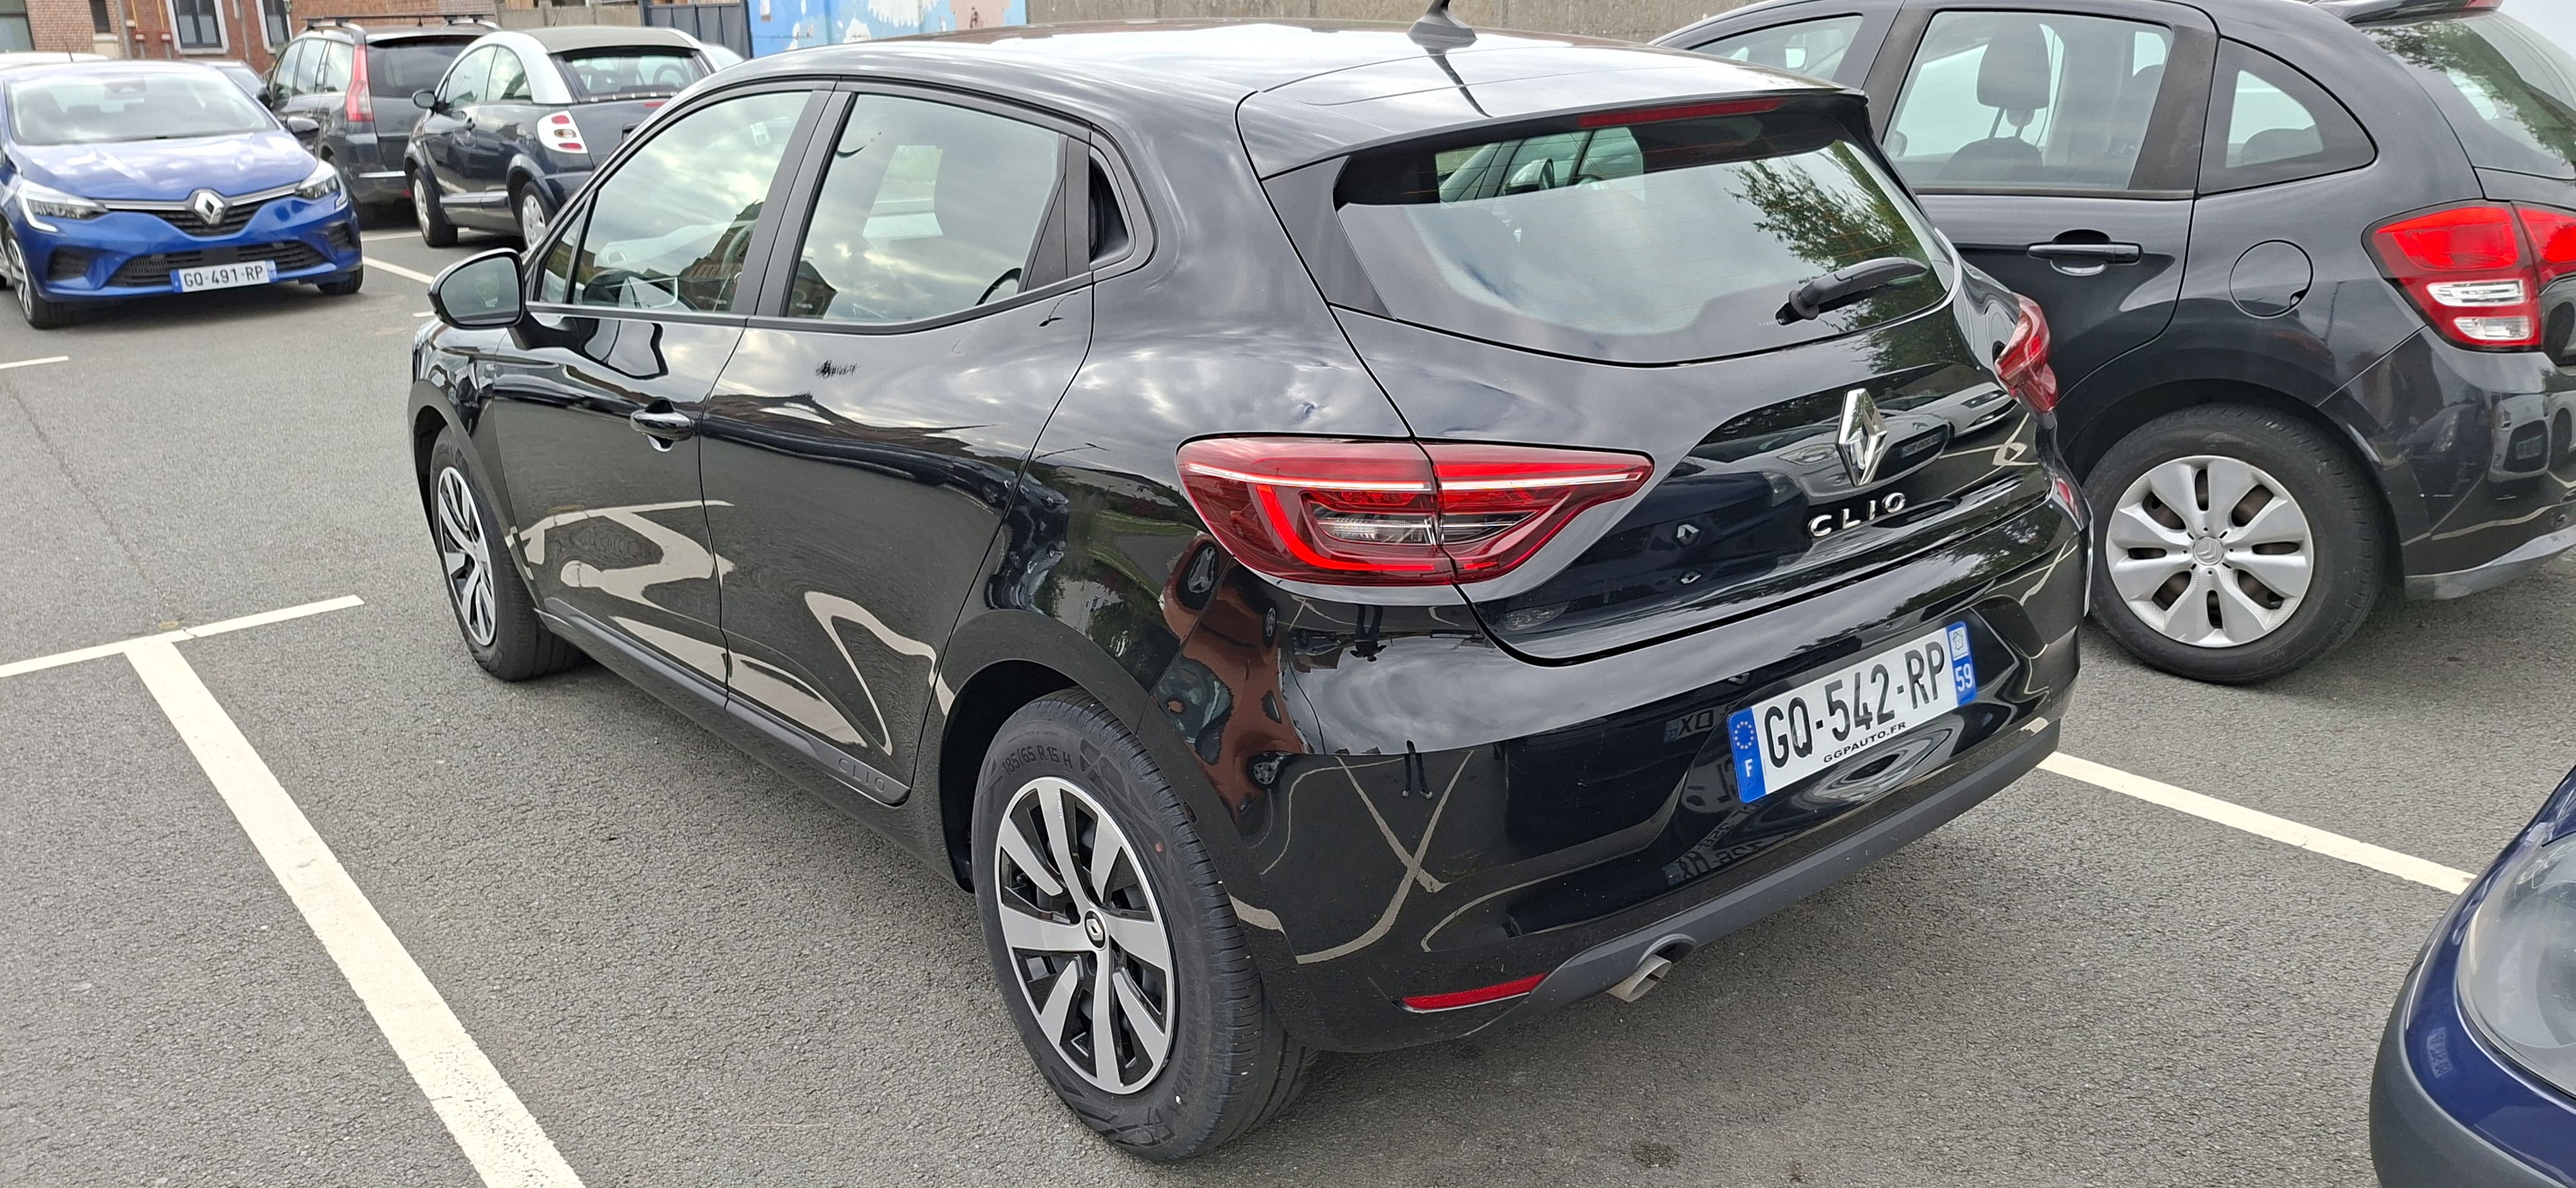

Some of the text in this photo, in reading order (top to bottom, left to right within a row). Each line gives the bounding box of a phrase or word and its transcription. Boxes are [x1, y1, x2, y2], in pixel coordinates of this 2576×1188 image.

[184, 265, 263, 287] GQ-491-RP
[1808, 492, 1906, 538] CLIO
[1955, 663, 1973, 692] 59
[1763, 641, 1945, 769] GQ-542-RP
[1823, 721, 1906, 763] GGPAUTO.FR
[838, 757, 886, 794] CLIO
[1002, 745, 1036, 775] 185/65
[1063, 751, 1073, 769] H
[1744, 758, 1753, 778] F
